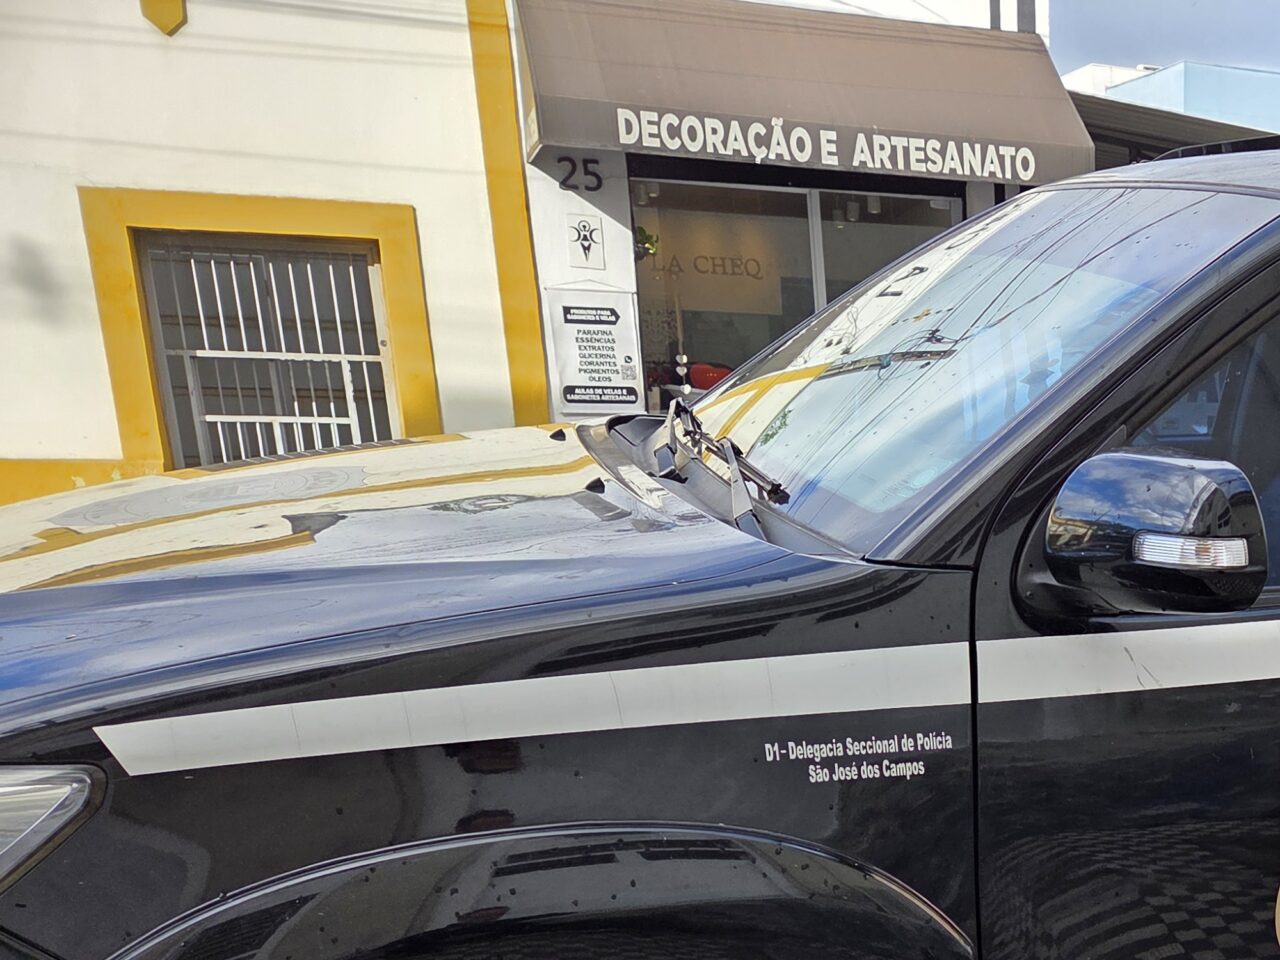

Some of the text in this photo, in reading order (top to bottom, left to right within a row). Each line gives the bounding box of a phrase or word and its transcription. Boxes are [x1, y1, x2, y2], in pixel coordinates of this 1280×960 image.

[617, 107, 1036, 181] DECORAÇÃO E ARTESANATO
[557, 156, 603, 192] 25
[787, 739, 844, 762] Delegacia
[845, 735, 899, 756] Seccional
[901, 734, 915, 751] de
[916, 731, 953, 751] Polícia
[808, 759, 925, 783] São José dos Campos
